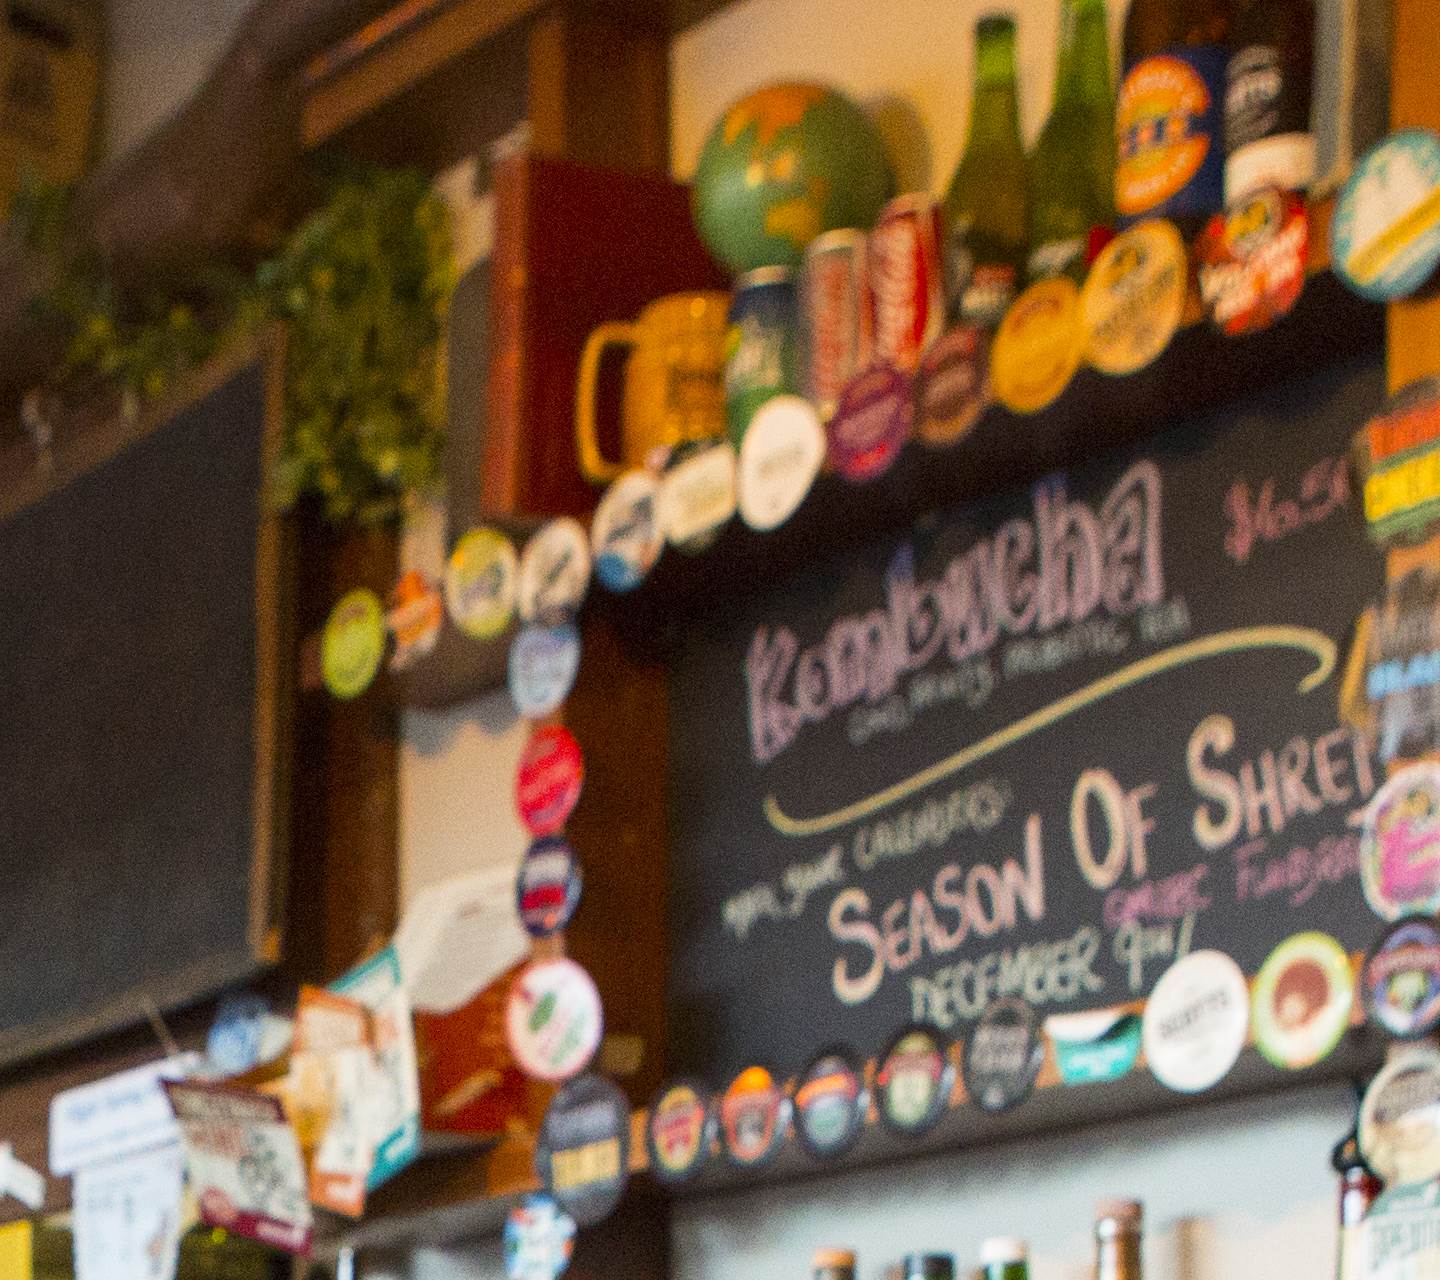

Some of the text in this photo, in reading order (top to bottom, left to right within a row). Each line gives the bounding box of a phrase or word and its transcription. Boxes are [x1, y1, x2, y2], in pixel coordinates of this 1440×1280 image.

[747, 460, 1166, 765] Kombucha
[828, 812, 1046, 1006] SEASON
[1070, 768, 1158, 889] OF
[909, 925, 1105, 1031] DECEMBER
